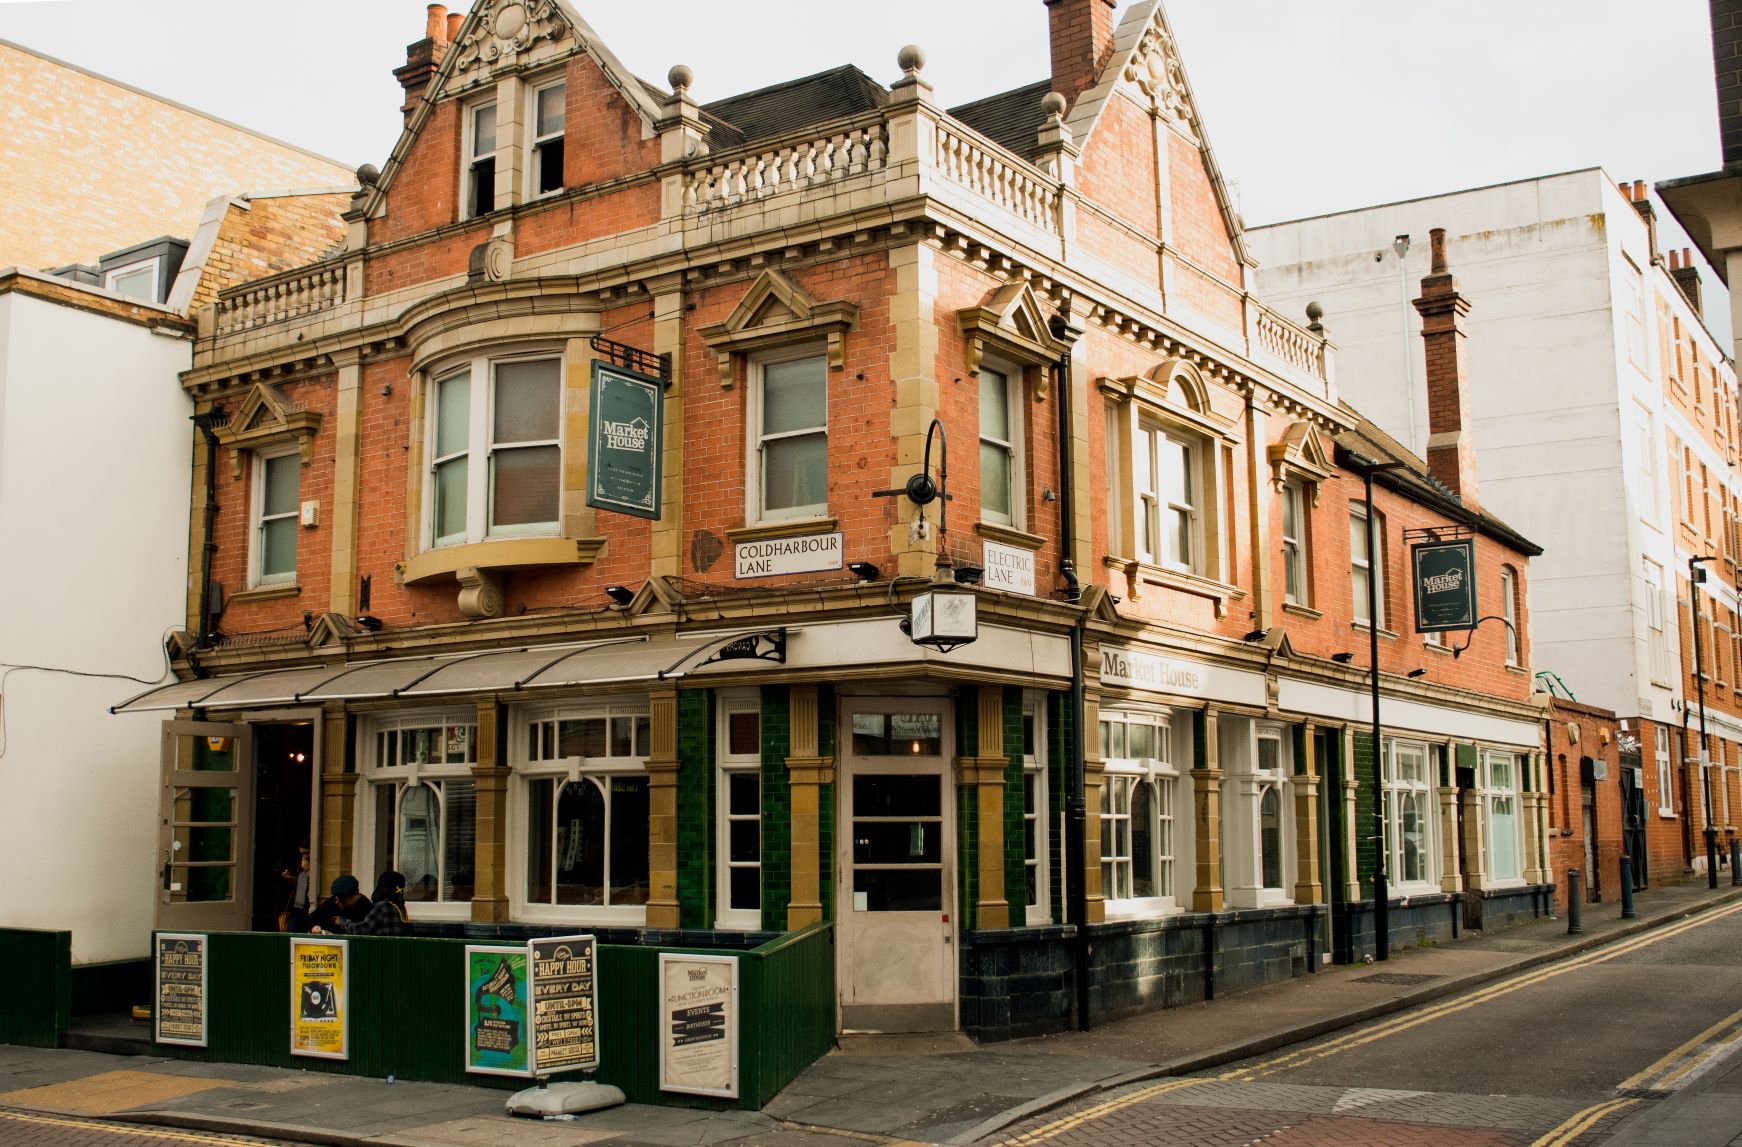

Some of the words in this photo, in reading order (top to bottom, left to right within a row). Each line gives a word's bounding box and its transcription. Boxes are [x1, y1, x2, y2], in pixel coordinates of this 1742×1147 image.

[603, 420, 649, 440] Market
[606, 434, 645, 449] House
[739, 537, 838, 560] COLDHARBOUR
[740, 560, 772, 575] LANE
[988, 549, 1031, 572] ELECTRIC
[988, 566, 1013, 584] LANE
[1423, 572, 1463, 587] Market
[1427, 580, 1460, 594] House
[1103, 651, 1157, 682] Market
[1158, 661, 1199, 690] House
[164, 953, 183, 964] HAPPY
[184, 954, 199, 965] HOUR
[300, 954, 320, 962] FRIDAY
[320, 954, 338, 962] NIGHT
[539, 960, 565, 976] HAPPY
[566, 960, 586, 974] HOUR
[535, 983, 570, 995] EVERY
[571, 981, 592, 992] DAY
[686, 1006, 710, 1017] EVENTS
